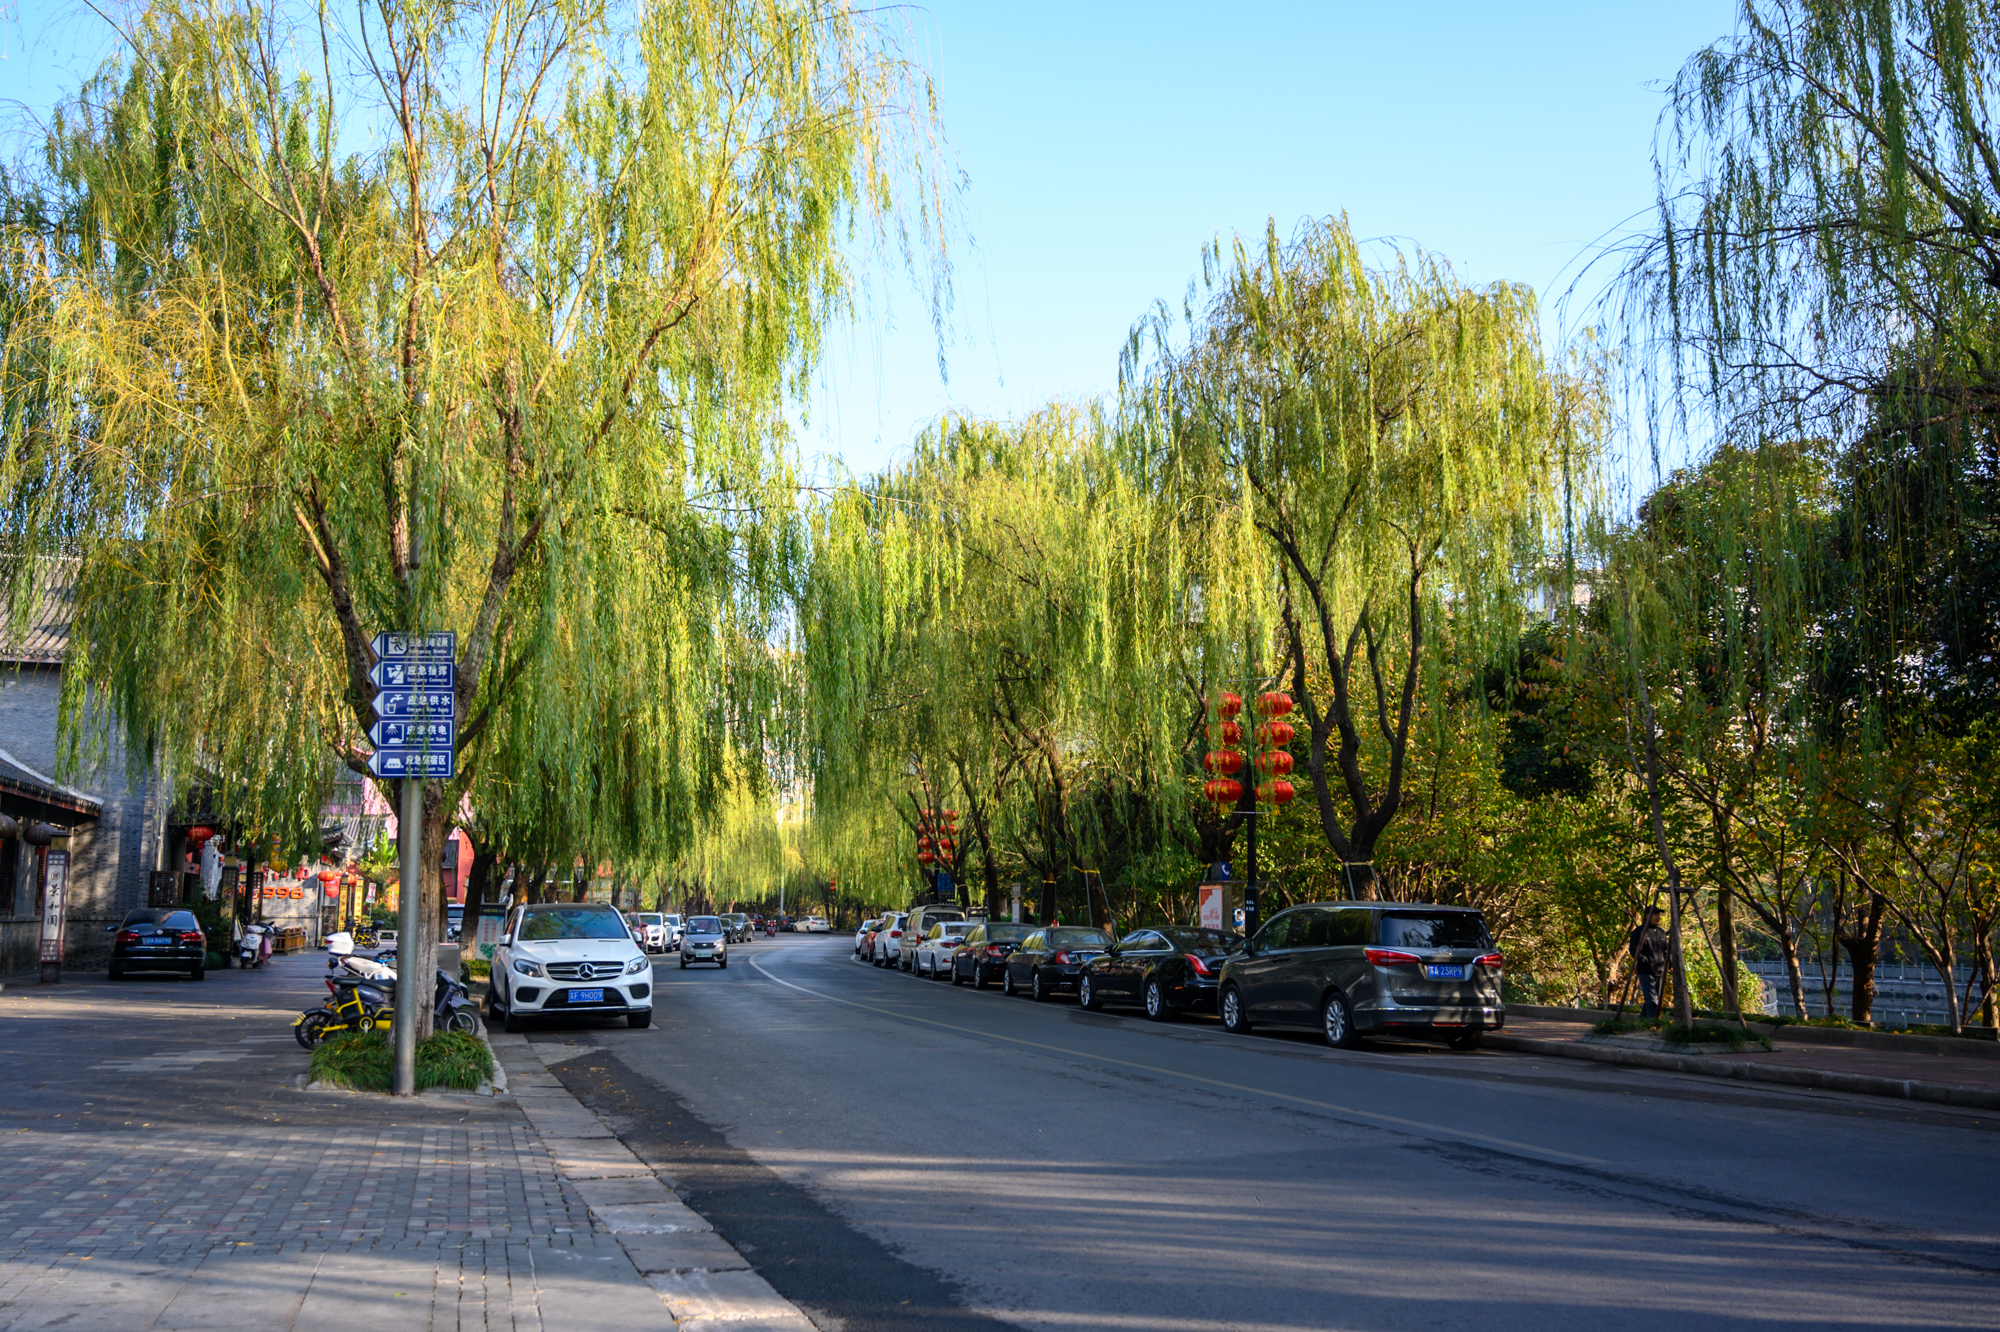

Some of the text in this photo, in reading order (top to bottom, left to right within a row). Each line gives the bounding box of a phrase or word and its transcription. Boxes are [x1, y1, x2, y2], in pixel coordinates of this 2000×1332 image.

[407, 665, 448, 676] 应急指挥
[407, 695, 450, 705] 应急供水
[406, 725, 447, 735] 应急供电
